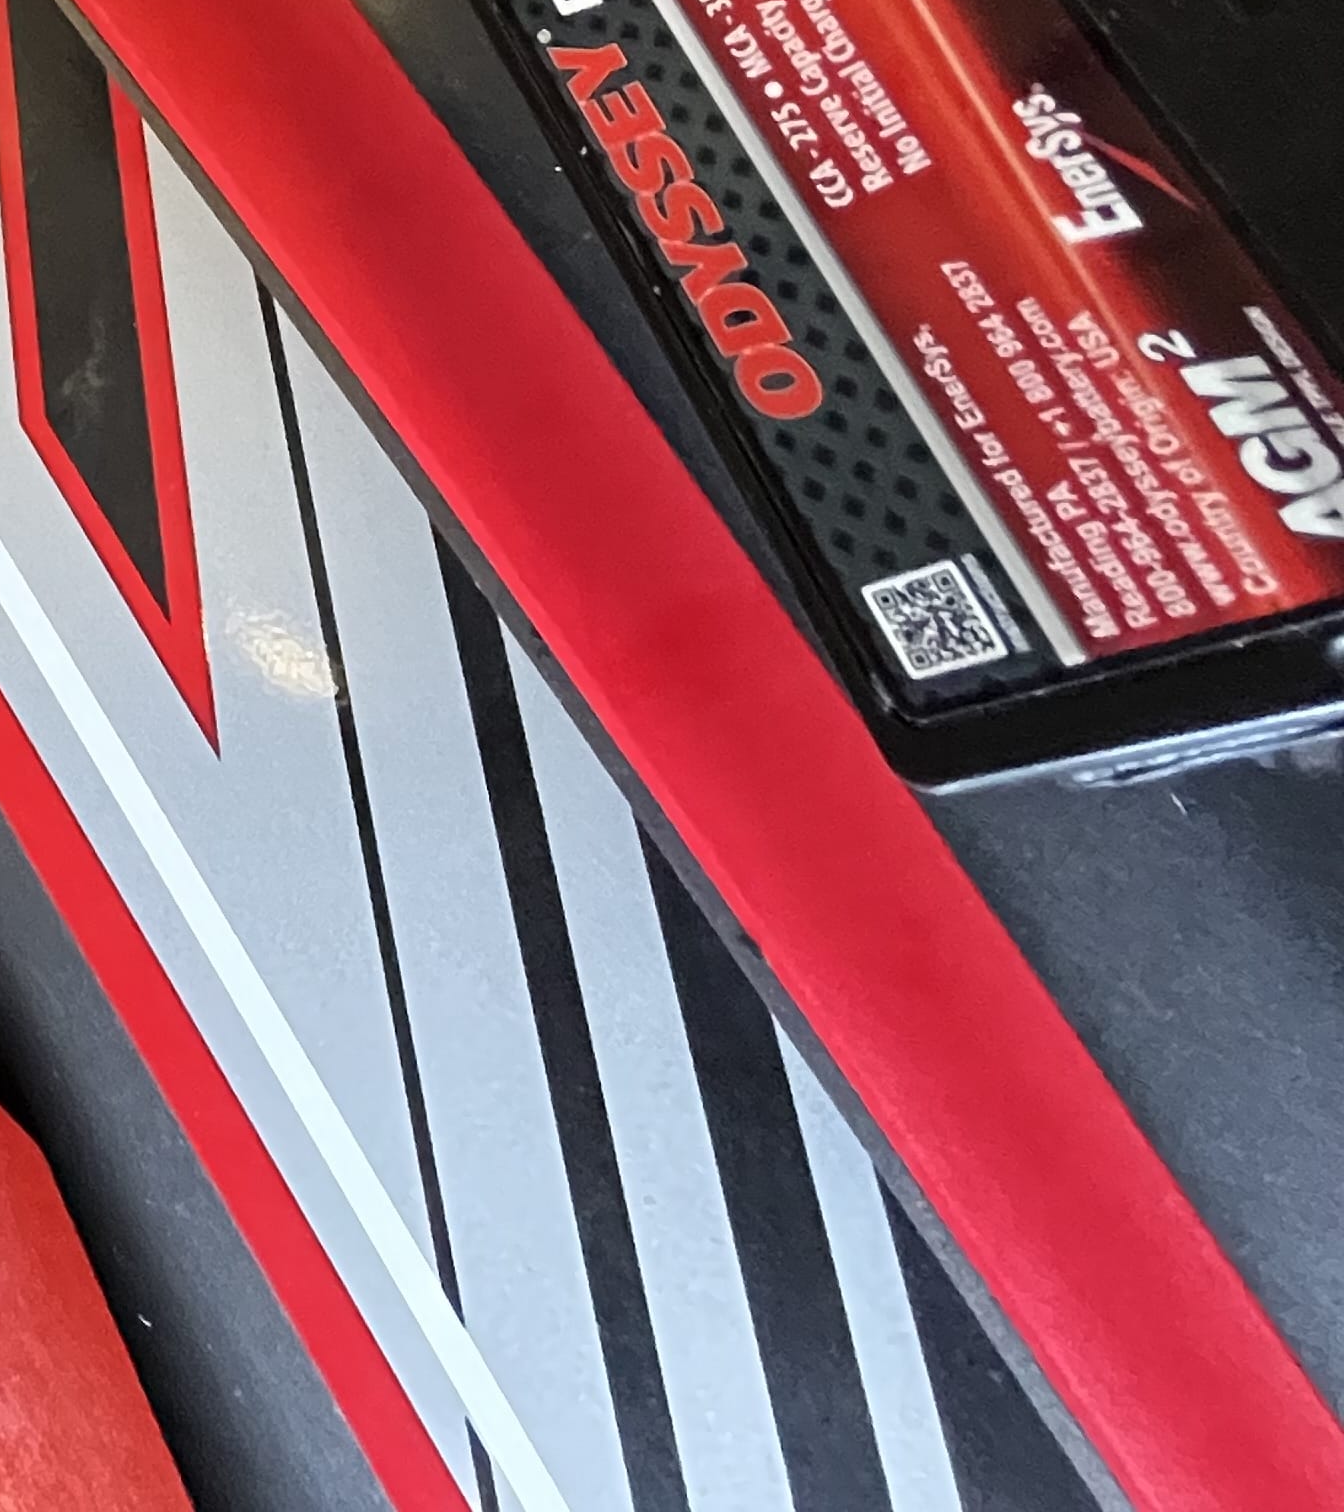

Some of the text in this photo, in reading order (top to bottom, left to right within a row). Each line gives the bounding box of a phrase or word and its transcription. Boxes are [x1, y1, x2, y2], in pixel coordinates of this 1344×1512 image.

[722, 22, 772, 79] MCA
[769, 101, 818, 151] 275
[836, 59, 907, 138] Initial
[818, 92, 894, 193] Reserve
[894, 134, 932, 175] No
[808, 157, 854, 208] CCA
[545, 41, 823, 420] ODYSSEY
[939, 260, 995, 314] 2837
[977, 312, 1024, 358] 964
[1066, 309, 1120, 369] USA
[1007, 358, 1054, 404] 800
[972, 431, 1010, 467] for
[1159, 457, 1206, 486] of
[1179, 354, 1344, 539] AGM
[992, 467, 1121, 639] Manufactured
[1045, 479, 1158, 629] Reading PA
[1067, 457, 1197, 618] 800-964-2837
[1192, 487, 1280, 597] Country
